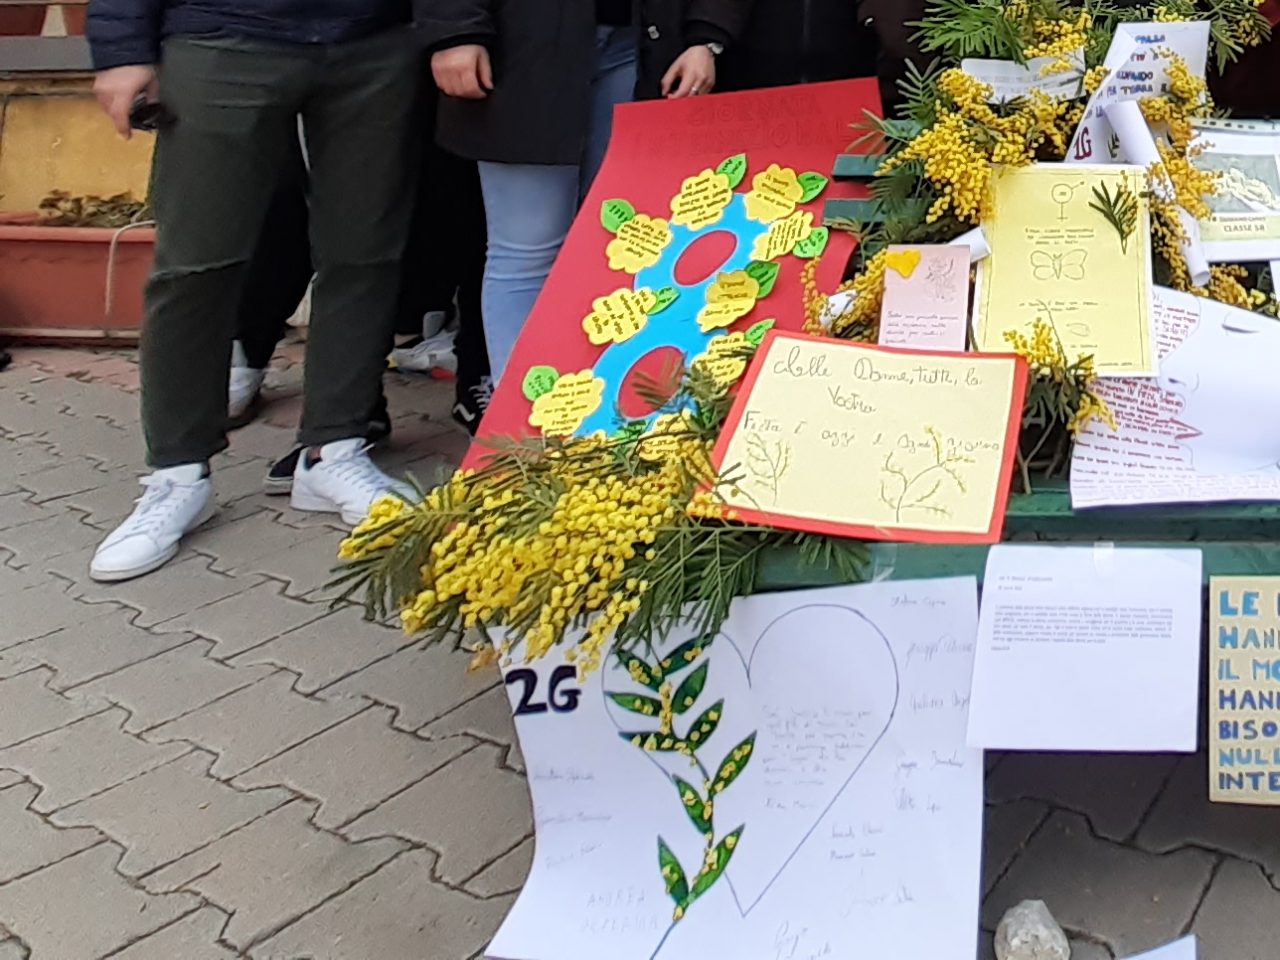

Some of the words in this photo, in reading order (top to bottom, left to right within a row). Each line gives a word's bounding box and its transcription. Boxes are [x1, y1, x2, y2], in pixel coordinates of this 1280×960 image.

[1219, 591, 1260, 617] LE
[1218, 660, 1240, 681] IL
[505, 664, 583, 715] 2G
